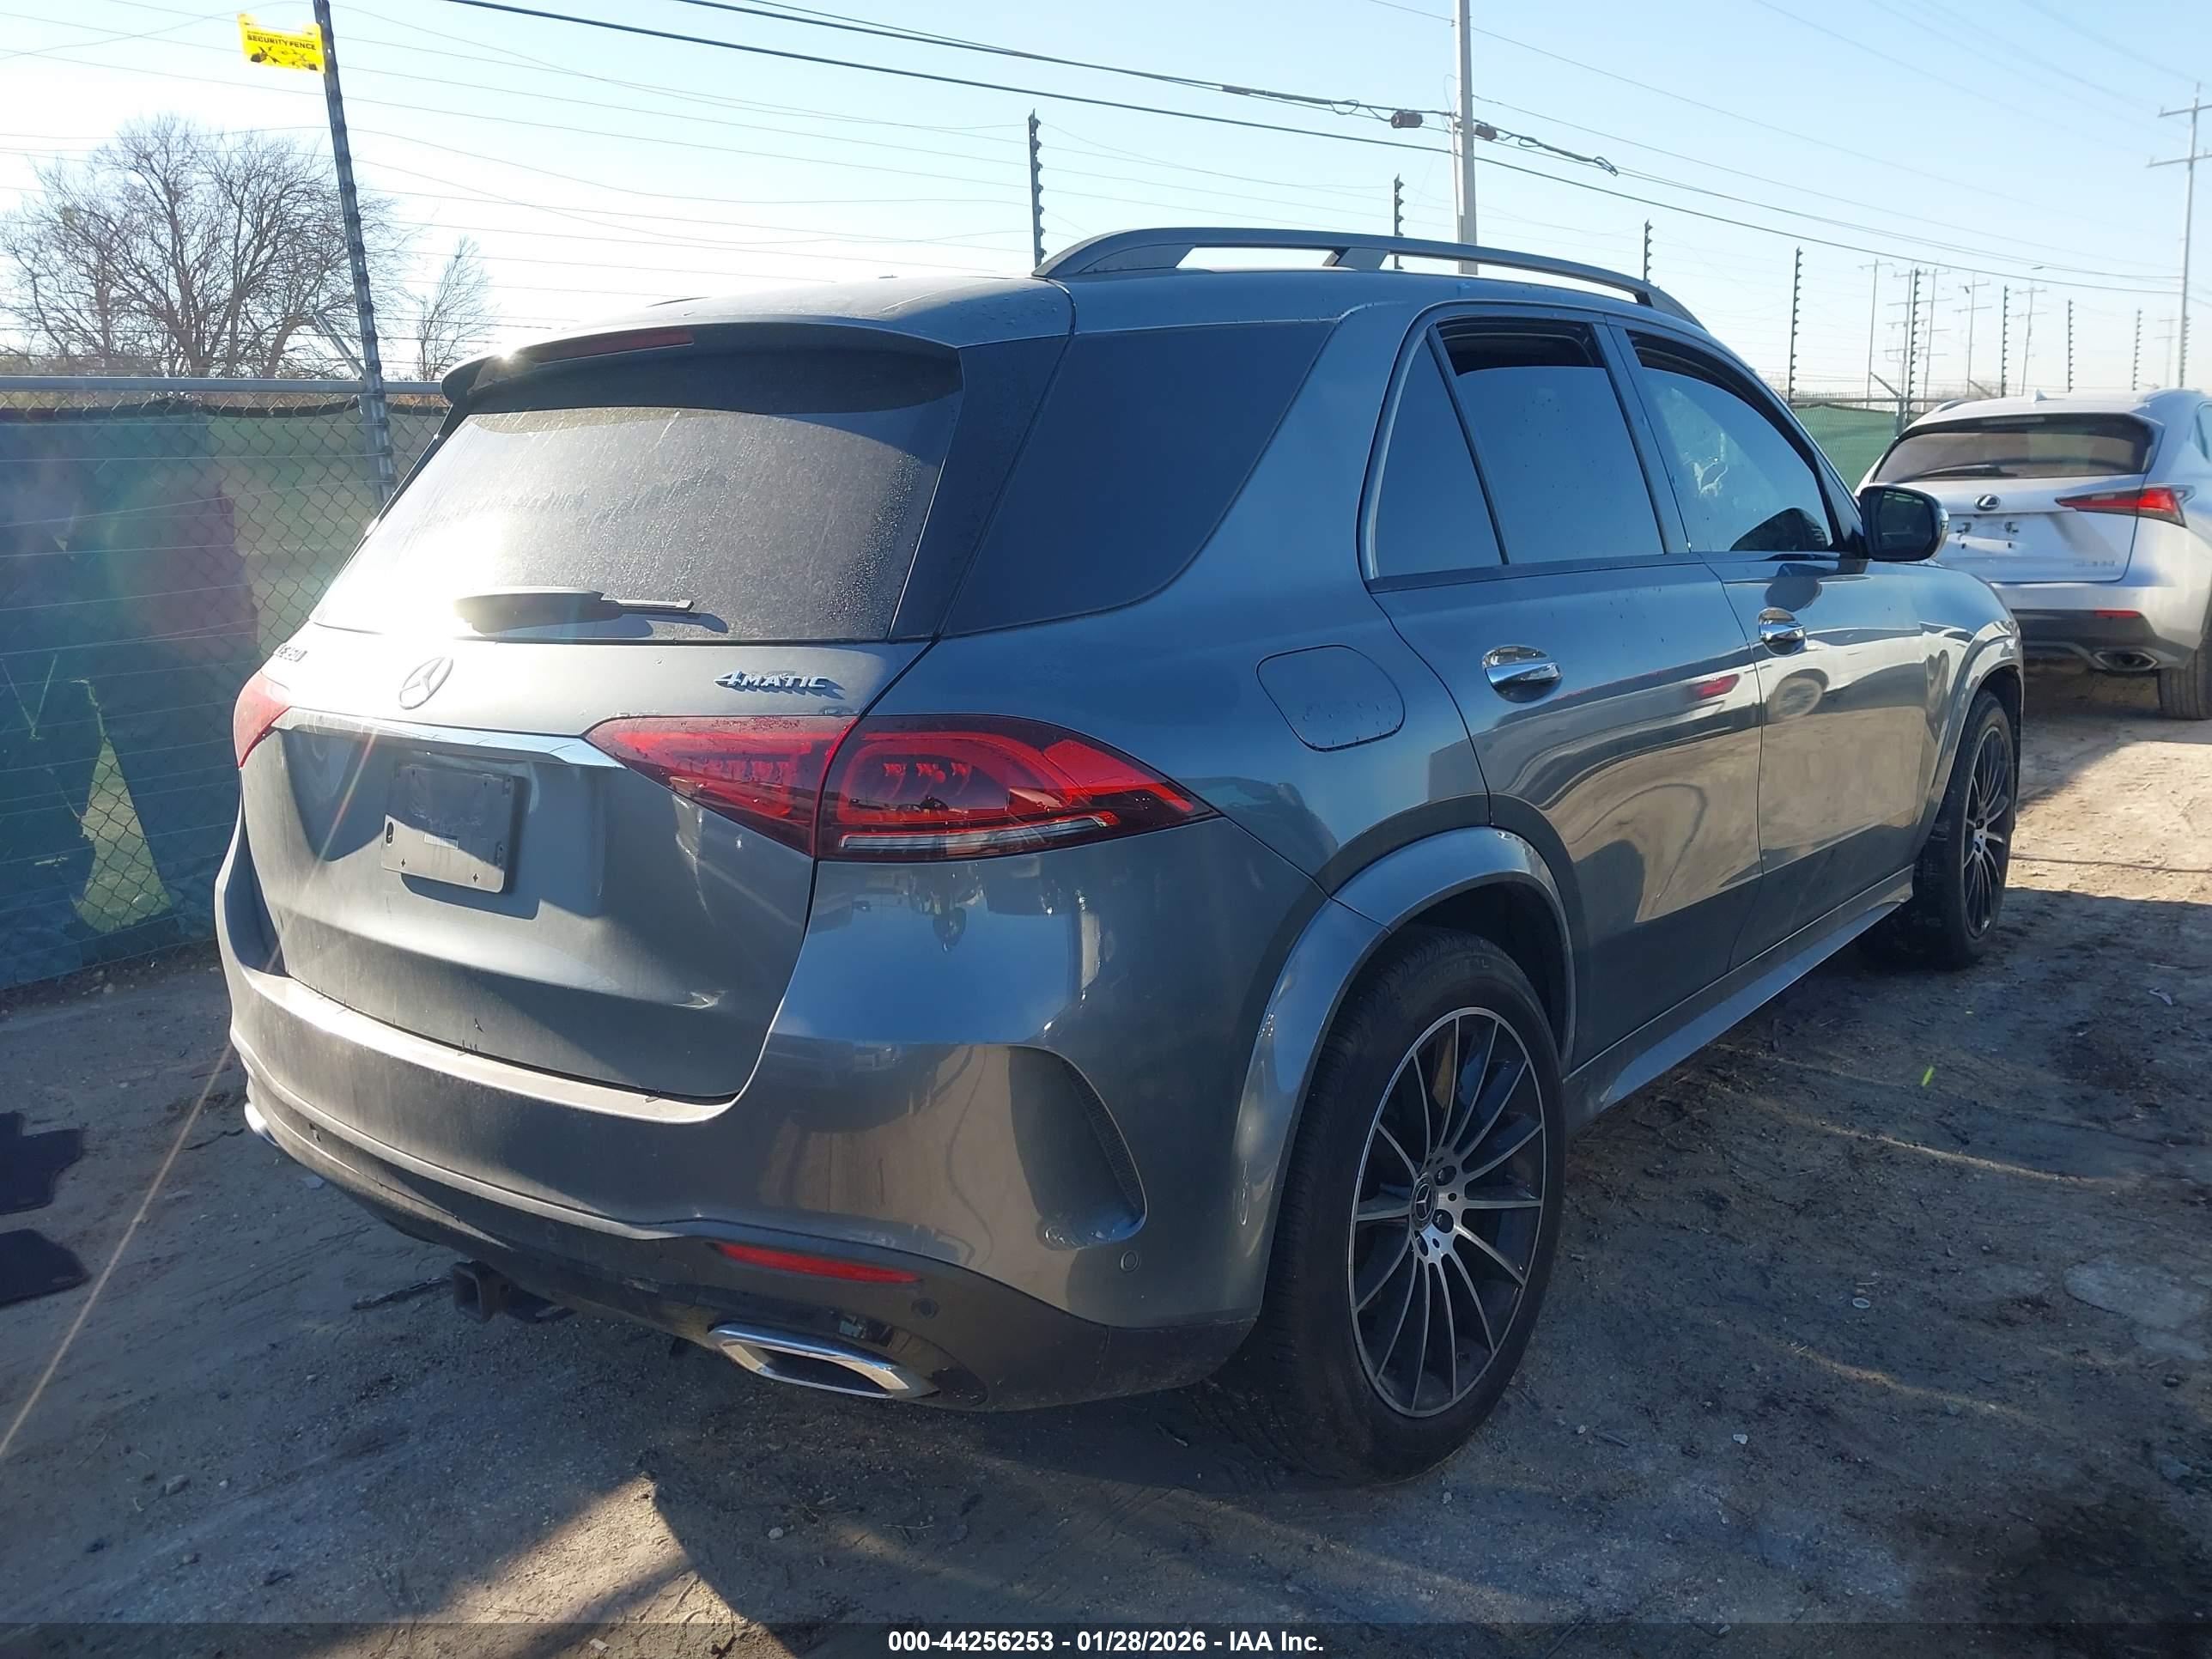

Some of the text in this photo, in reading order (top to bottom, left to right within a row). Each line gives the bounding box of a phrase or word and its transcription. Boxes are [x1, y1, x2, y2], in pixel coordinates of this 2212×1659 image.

[247, 33, 289, 46] SECURITY
[289, 40, 317, 51] FENCE
[714, 671, 827, 689] 4MATIC
